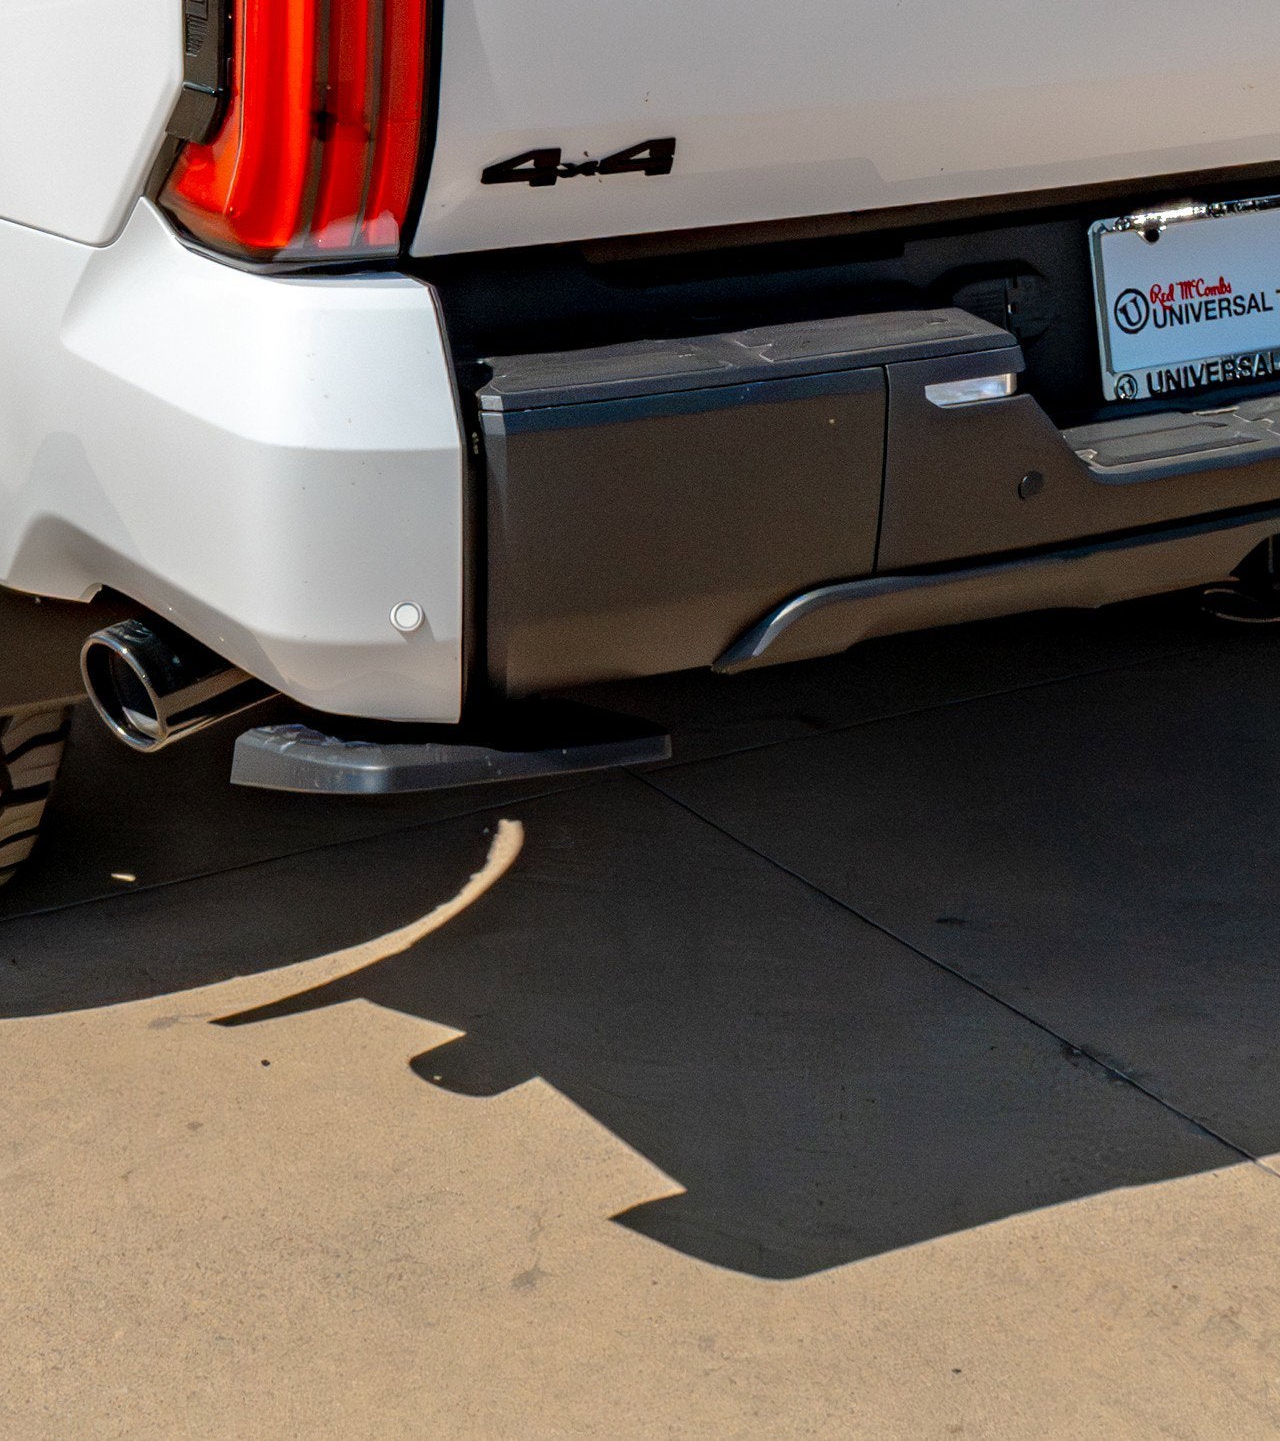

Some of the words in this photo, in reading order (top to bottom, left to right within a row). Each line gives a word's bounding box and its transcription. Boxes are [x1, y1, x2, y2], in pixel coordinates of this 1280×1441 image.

[480, 137, 676, 187] 4x4
[1150, 283, 1175, 307] Red
[1177, 276, 1232, 302] McCombs
[1152, 291, 1273, 329] UNIVERSAL
[1146, 353, 1277, 397] UNIVERSAL
